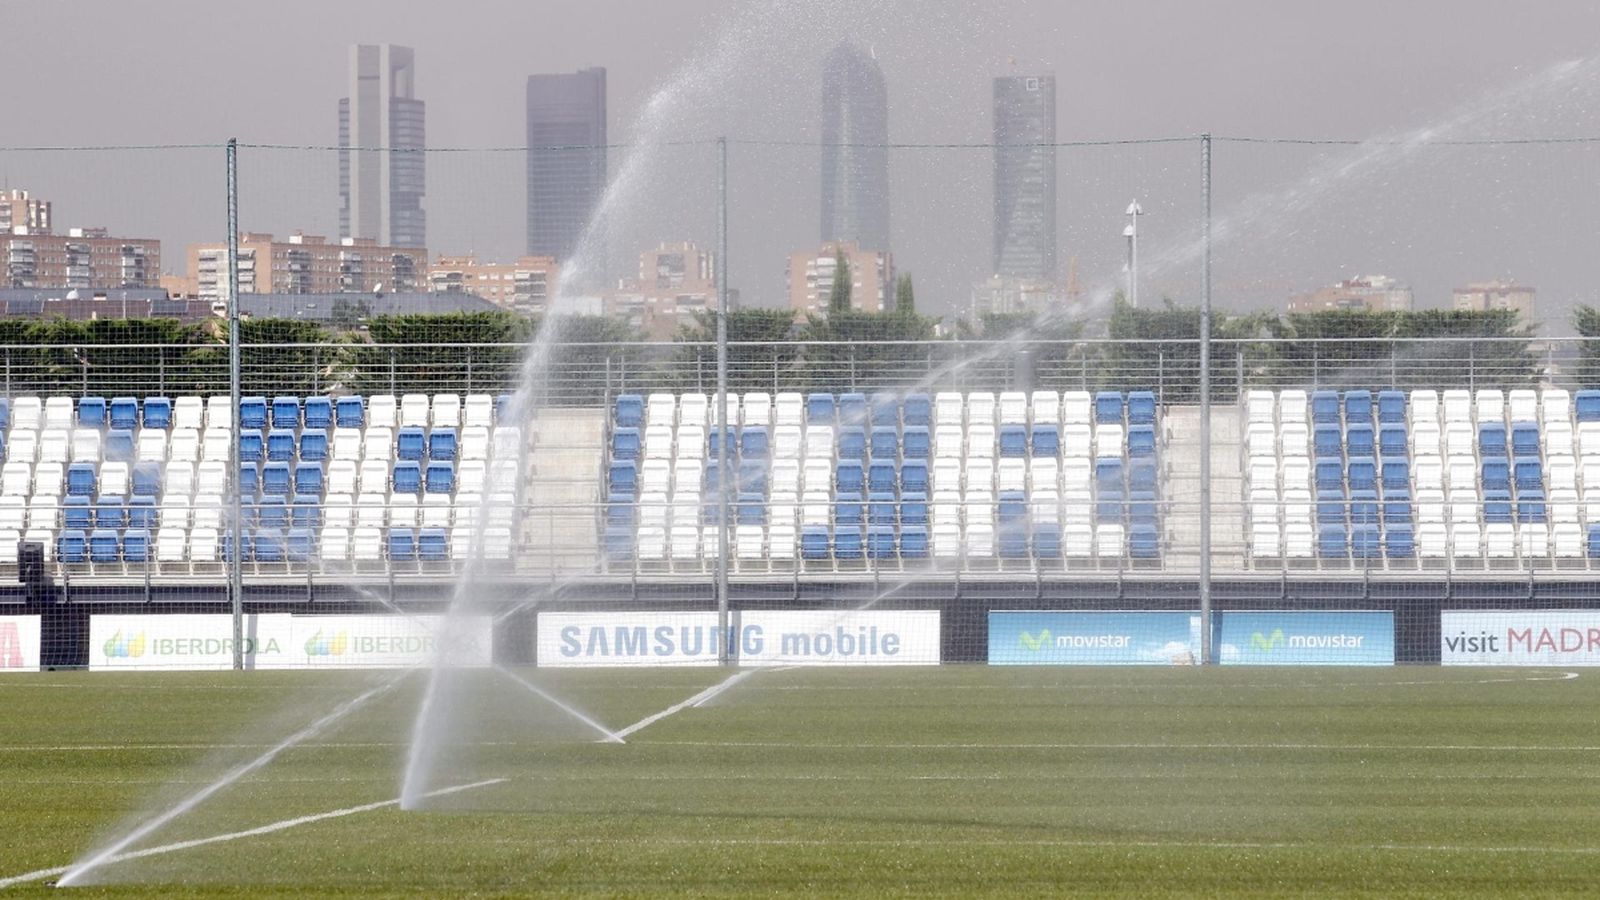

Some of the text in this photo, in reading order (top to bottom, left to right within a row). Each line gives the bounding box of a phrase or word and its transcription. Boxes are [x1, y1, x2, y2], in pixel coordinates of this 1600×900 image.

[354, 636, 476, 653] IBERDR
[560, 624, 900, 657] SAMSUNG mobile
[1056, 634, 1131, 648] movistar
[1289, 634, 1364, 648] movistar
[1445, 627, 1600, 653] visit MADR
